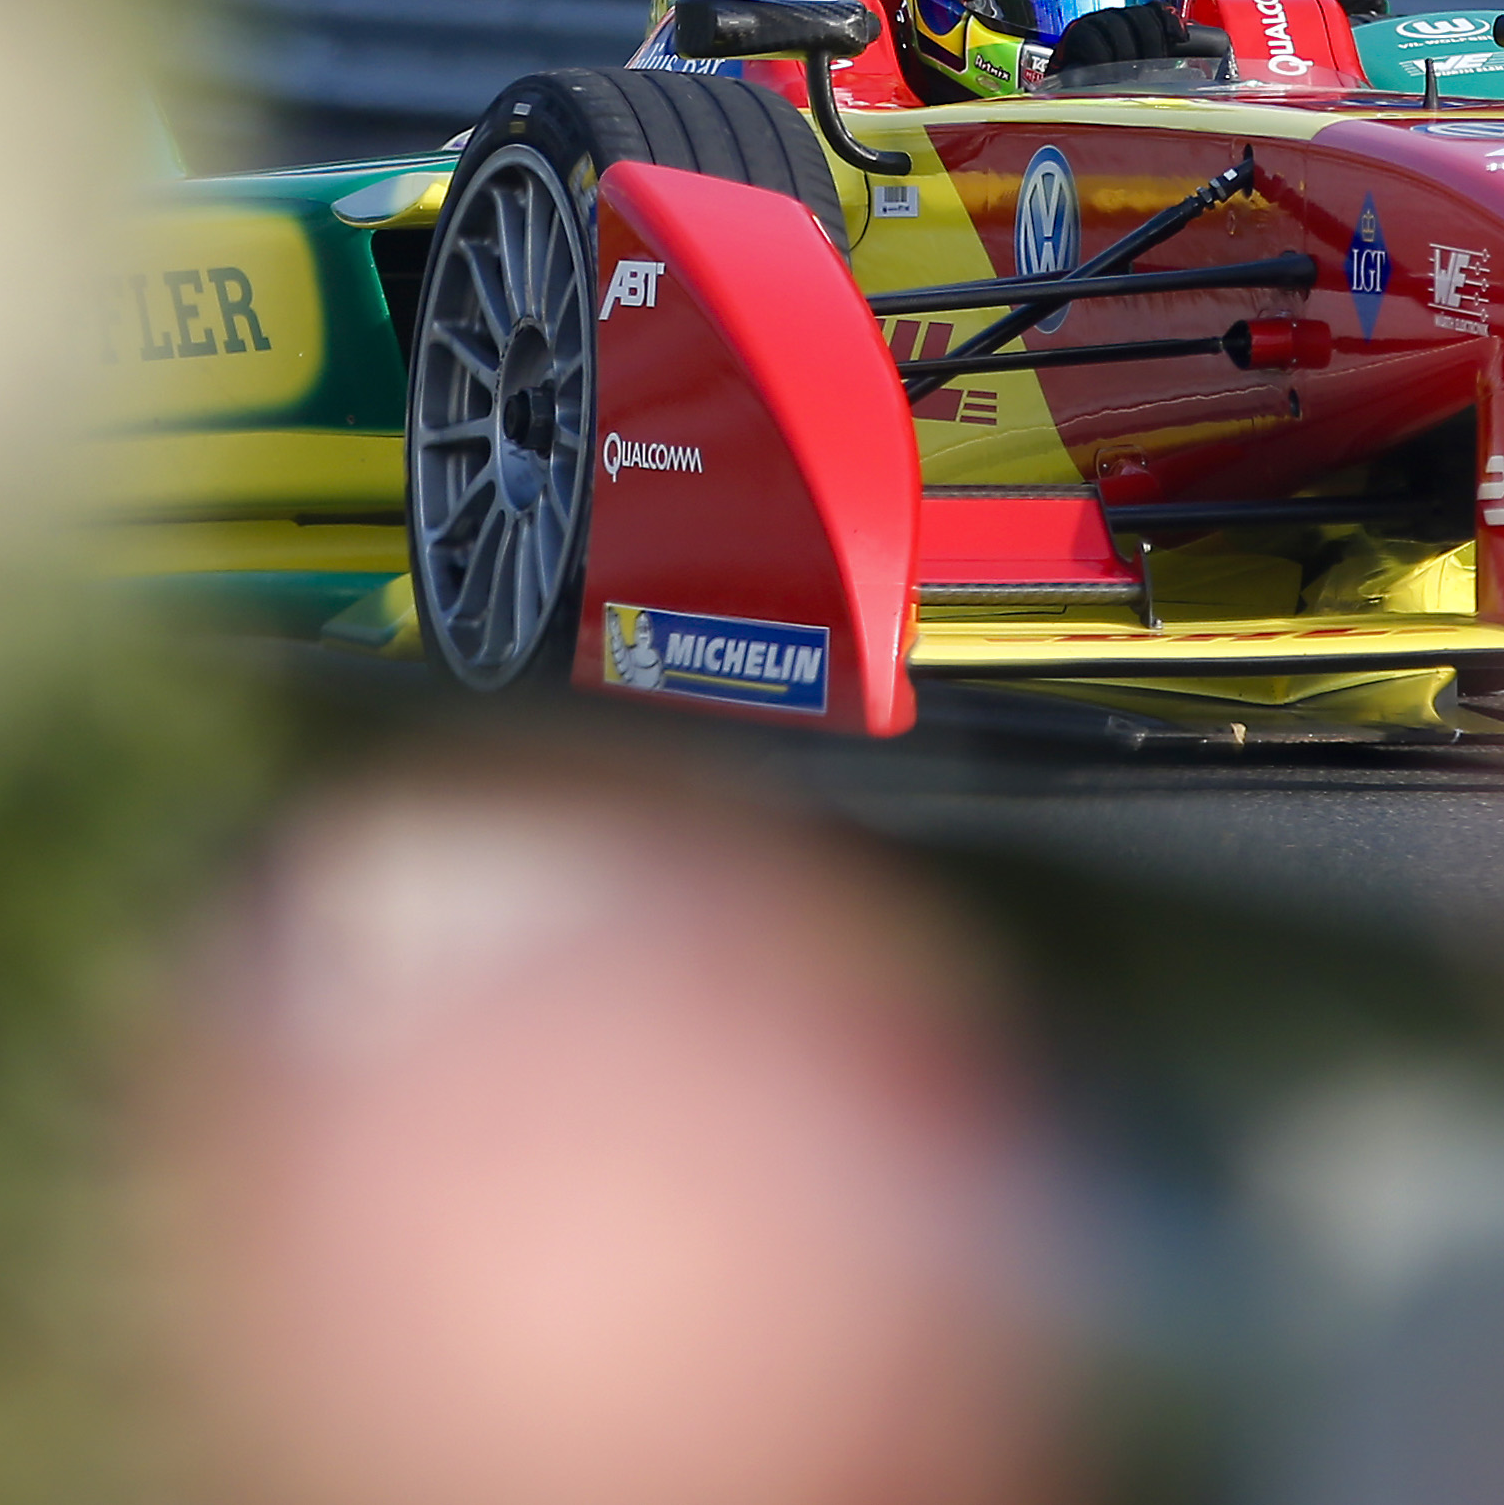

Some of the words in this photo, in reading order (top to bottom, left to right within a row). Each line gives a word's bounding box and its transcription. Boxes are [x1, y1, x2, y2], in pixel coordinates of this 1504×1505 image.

[599, 260, 665, 321] ABT
[1352, 249, 1386, 292] LGT
[603, 432, 703, 482] QUALCOMM
[665, 632, 823, 684] MICHELIN
